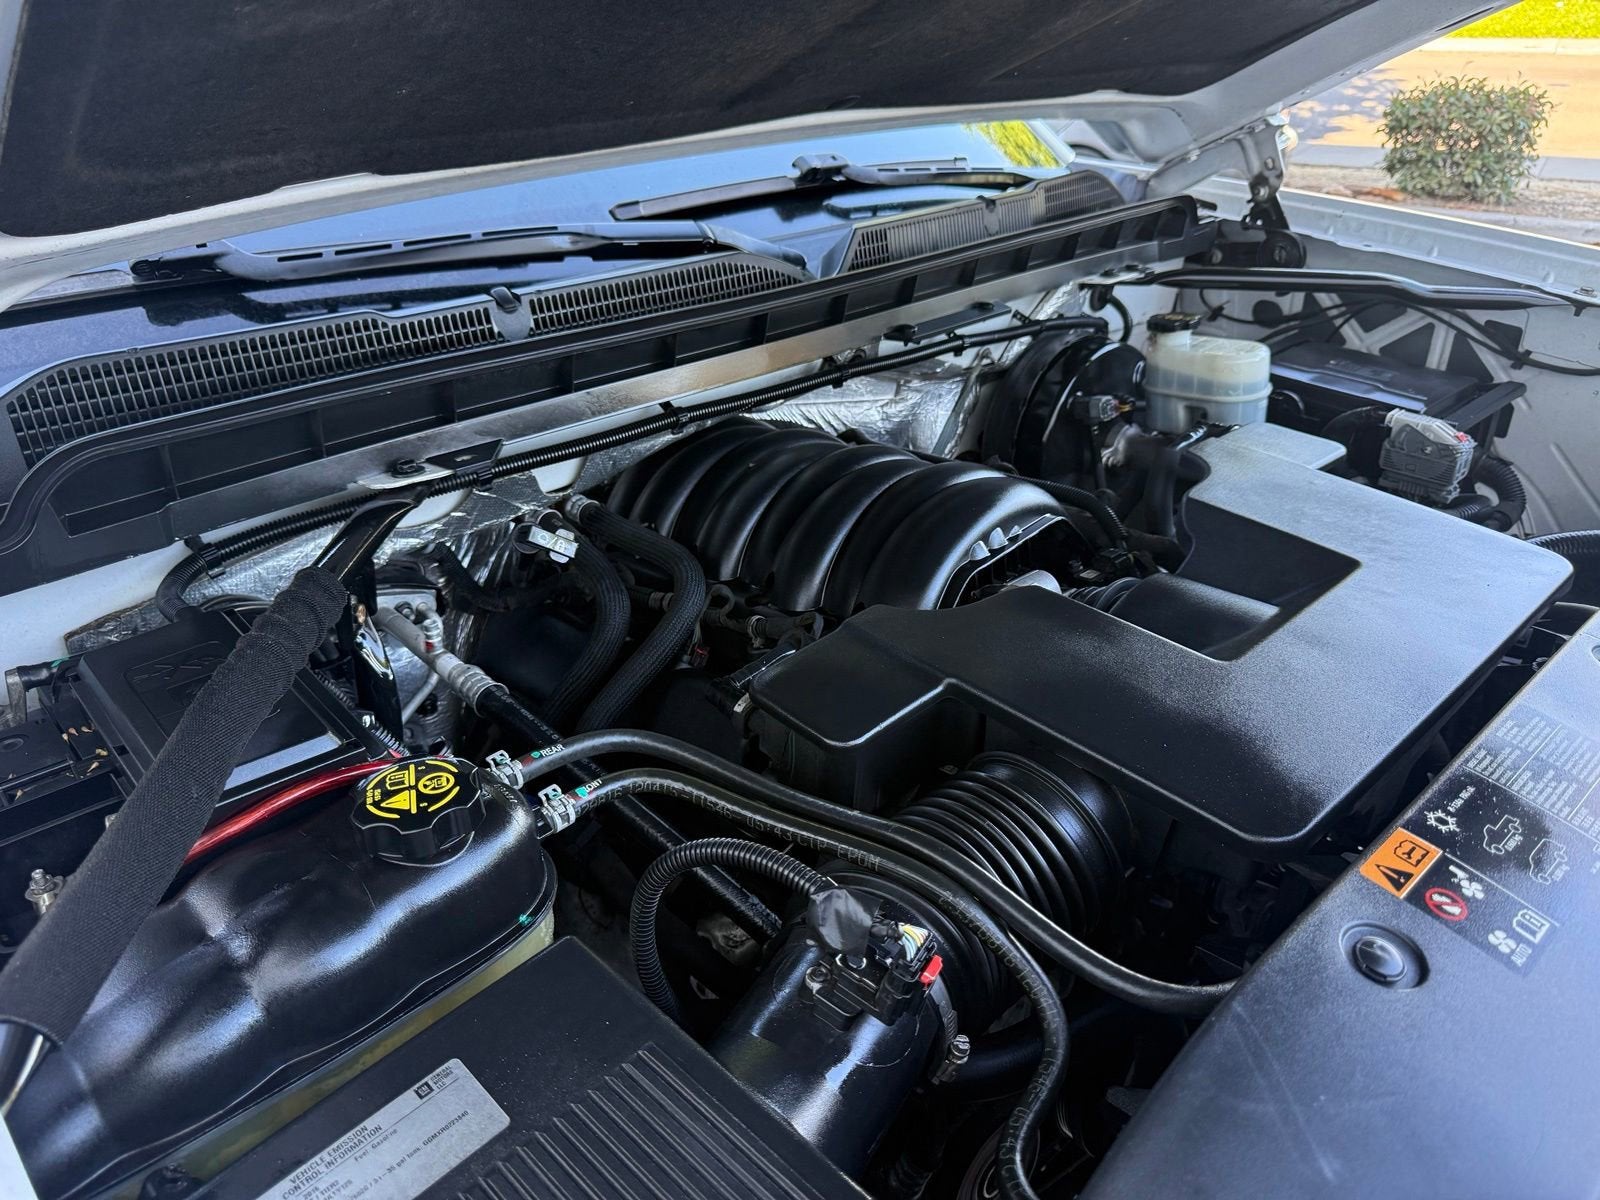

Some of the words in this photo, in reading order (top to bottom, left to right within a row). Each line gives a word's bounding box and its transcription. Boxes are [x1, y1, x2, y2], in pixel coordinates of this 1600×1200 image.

[540, 744, 565, 757] REAR
[1510, 943, 1532, 967] AUTO
[432, 1070, 454, 1086] MOTORS
[282, 1169, 325, 1200] CONTROL
[325, 1124, 383, 1169] INFORMATION
[290, 1156, 326, 1184] VEHICLE
[327, 1125, 368, 1157] EMISSION
